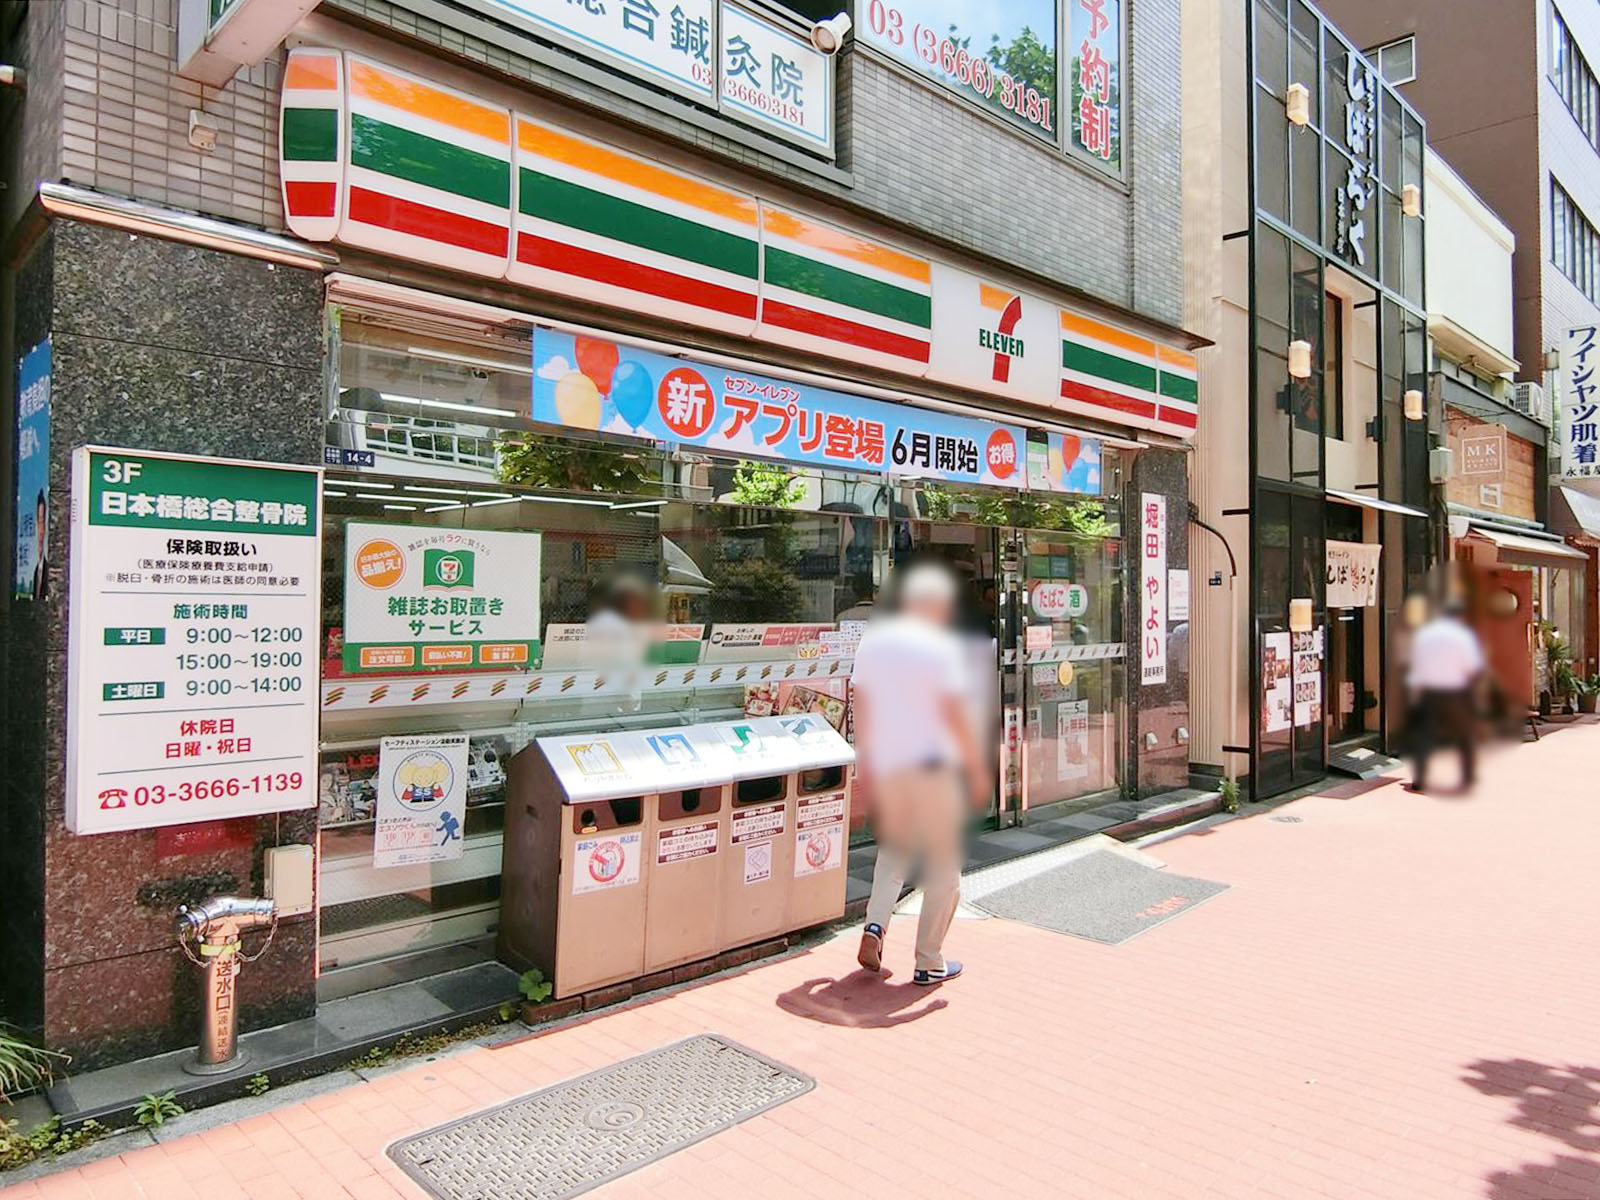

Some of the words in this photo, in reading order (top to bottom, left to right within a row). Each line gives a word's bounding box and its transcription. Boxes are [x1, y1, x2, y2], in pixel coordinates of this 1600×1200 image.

[869, 0, 904, 46] 03
[912, 23, 994, 99] (3666)
[1000, 74, 1053, 132] 3181
[1078, 0, 1111, 160] 予約制
[979, 282, 1023, 383] 7
[667, 377, 706, 428] 新
[1569, 326, 1599, 464] ワイシャツ肌着
[722, 395, 885, 465] アプリ登場
[347, 452, 372, 464] 14-4
[891, 428, 979, 474] 6月開始
[988, 443, 1016, 465] お得
[103, 461, 142, 484] 3F
[101, 491, 308, 526] 日本橋総合整骨院
[1145, 503, 1159, 558] 堀田
[166, 539, 257, 557] 保険取扱い
[388, 596, 505, 617] 雑誌お取置き
[1039, 589, 1065, 608] たばこ
[173, 603, 248, 620] 施術時間
[1145, 576, 1159, 659] やよい
[120, 629, 152, 645] 平日
[408, 619, 484, 637] サービス
[111, 684, 158, 699] 土曜日
[180, 718, 235, 737] 休院日
[165, 737, 252, 759] 日曜・祝日
[134, 772, 303, 807] 03-3666-1139
